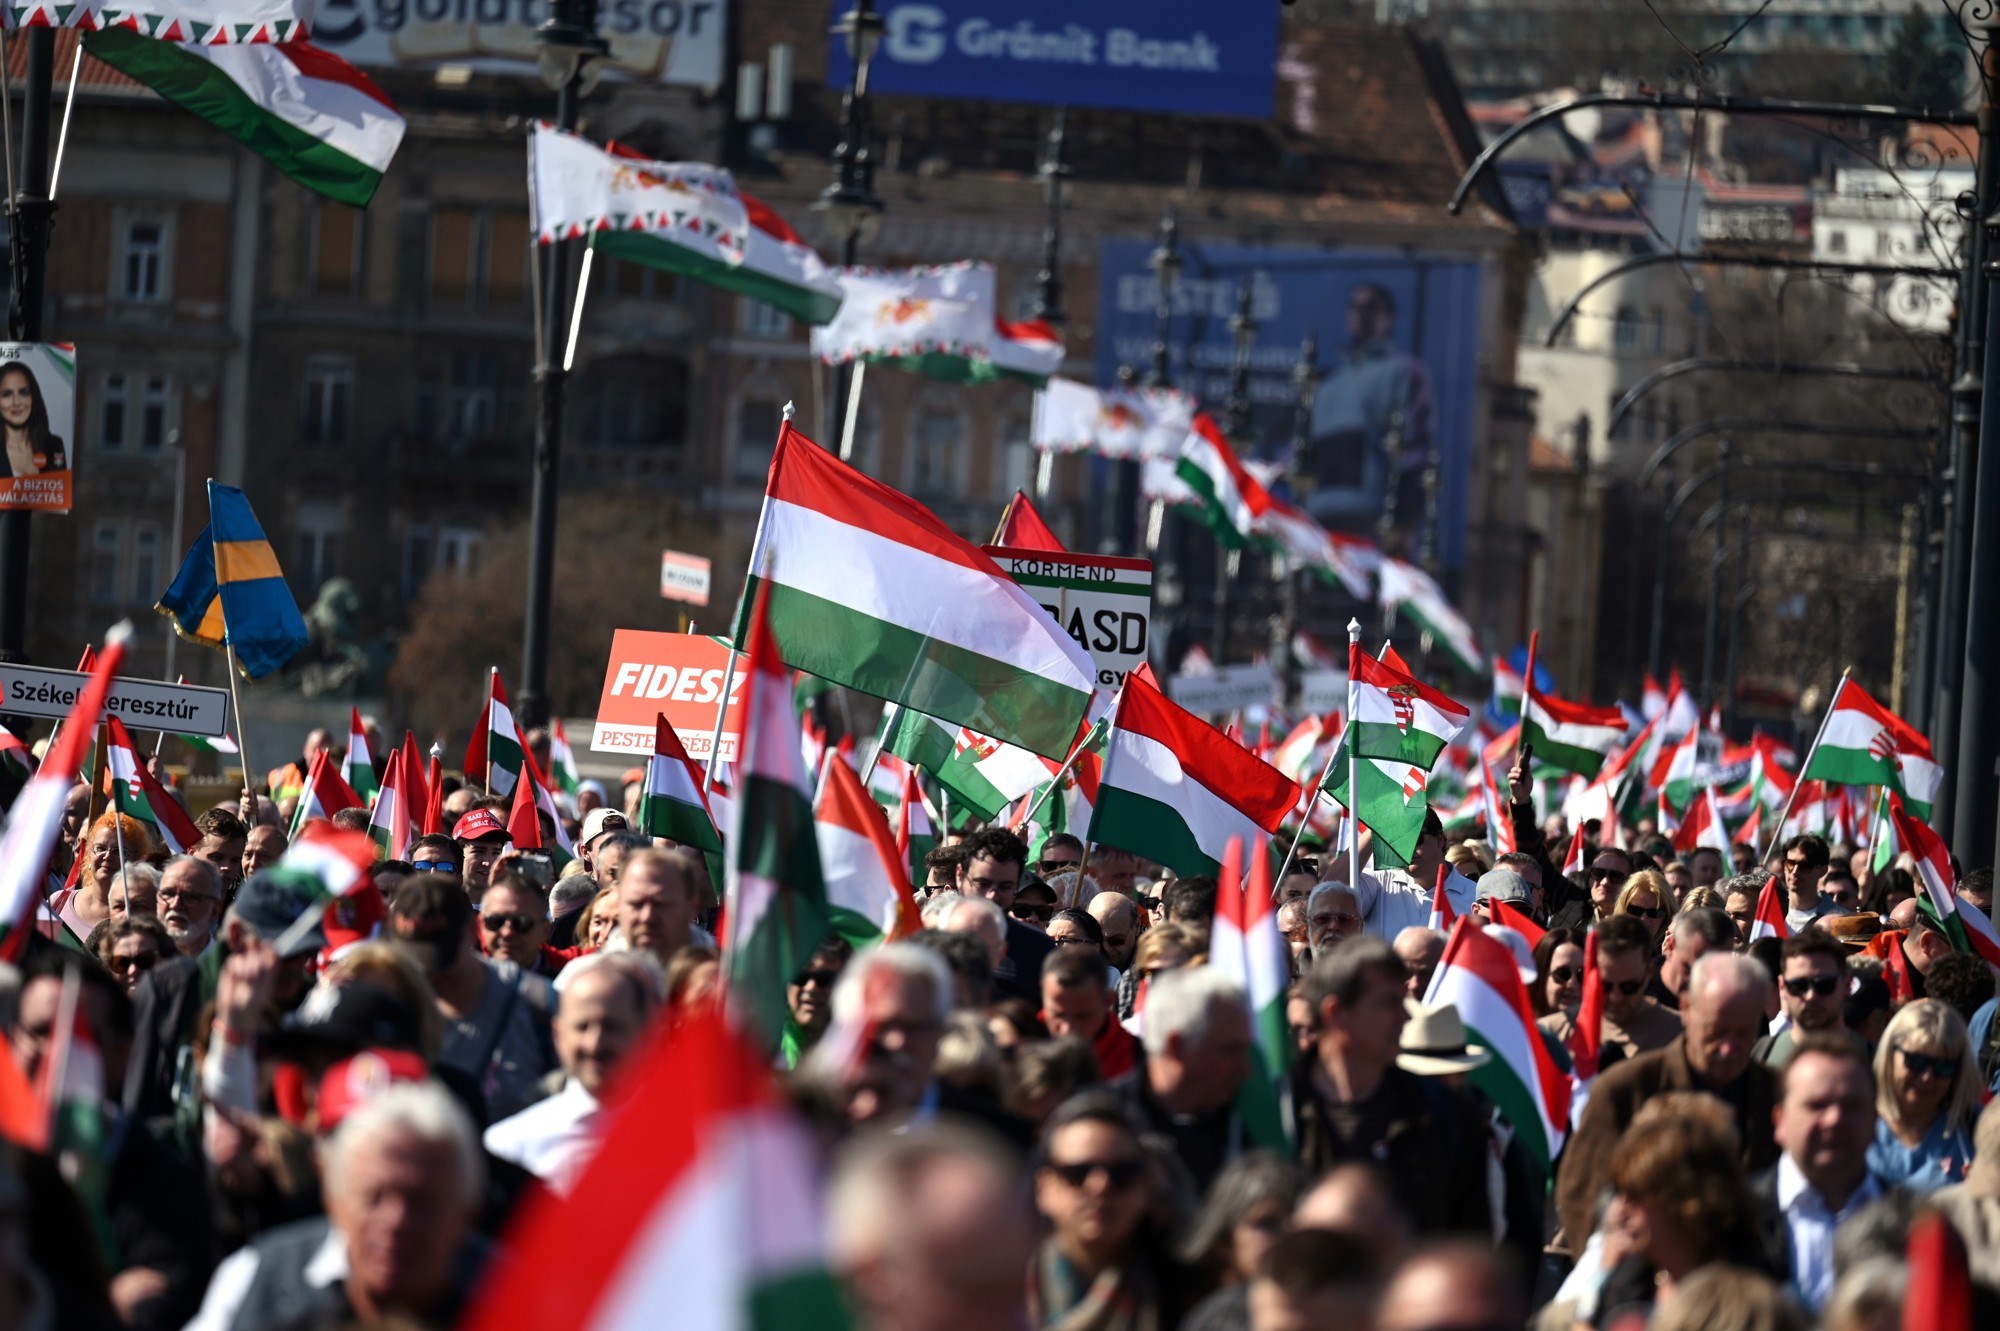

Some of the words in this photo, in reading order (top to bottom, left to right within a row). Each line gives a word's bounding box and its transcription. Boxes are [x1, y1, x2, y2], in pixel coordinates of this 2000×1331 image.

[957, 18, 1098, 64] Gránit
[1106, 28, 1220, 71] Bank
[13, 478, 21, 490] A
[24, 479, 63, 491] BIZTOS
[1011, 558, 1116, 582] KÖRMEND
[610, 662, 749, 705] FIDESZ
